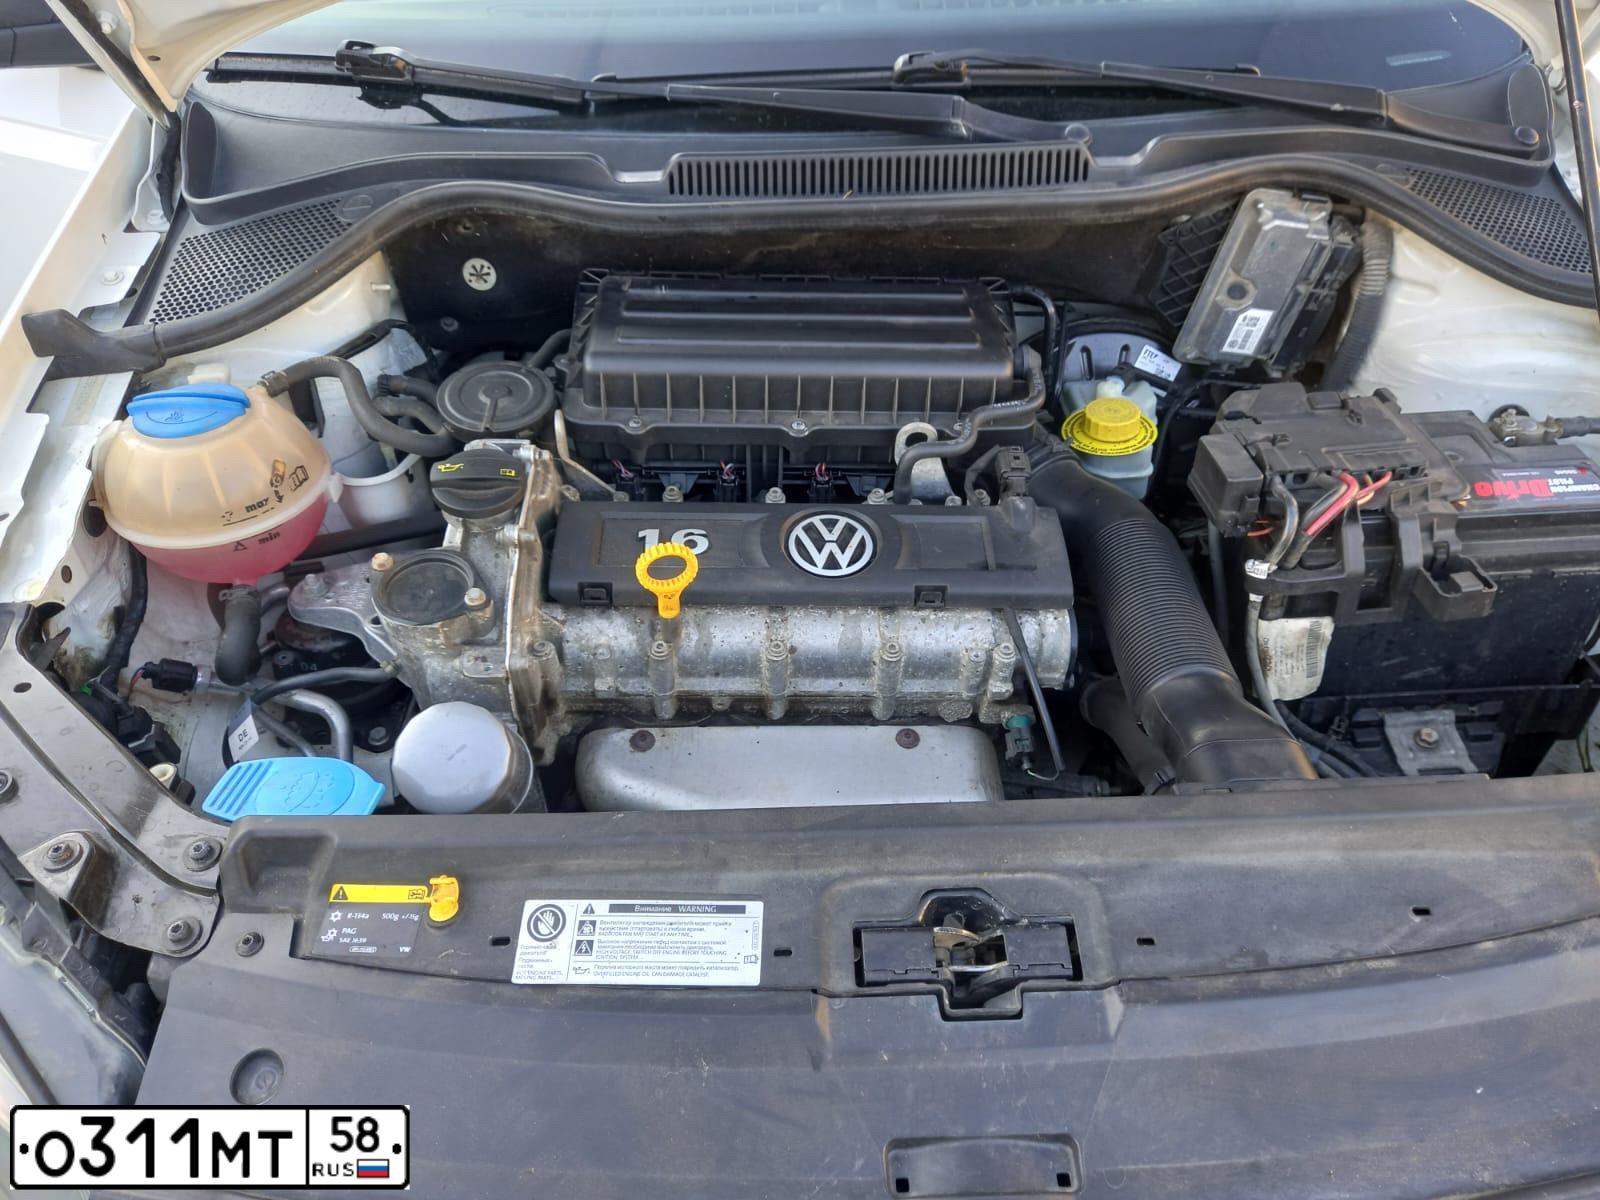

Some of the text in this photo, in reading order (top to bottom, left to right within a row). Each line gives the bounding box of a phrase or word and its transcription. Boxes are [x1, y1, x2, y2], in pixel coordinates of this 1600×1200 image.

[245, 497, 269, 513] max
[258, 532, 280, 545] min
[634, 904, 717, 913] Внимание WARNING
[381, 912, 400, 922] 500g
[341, 927, 358, 935] PAG
